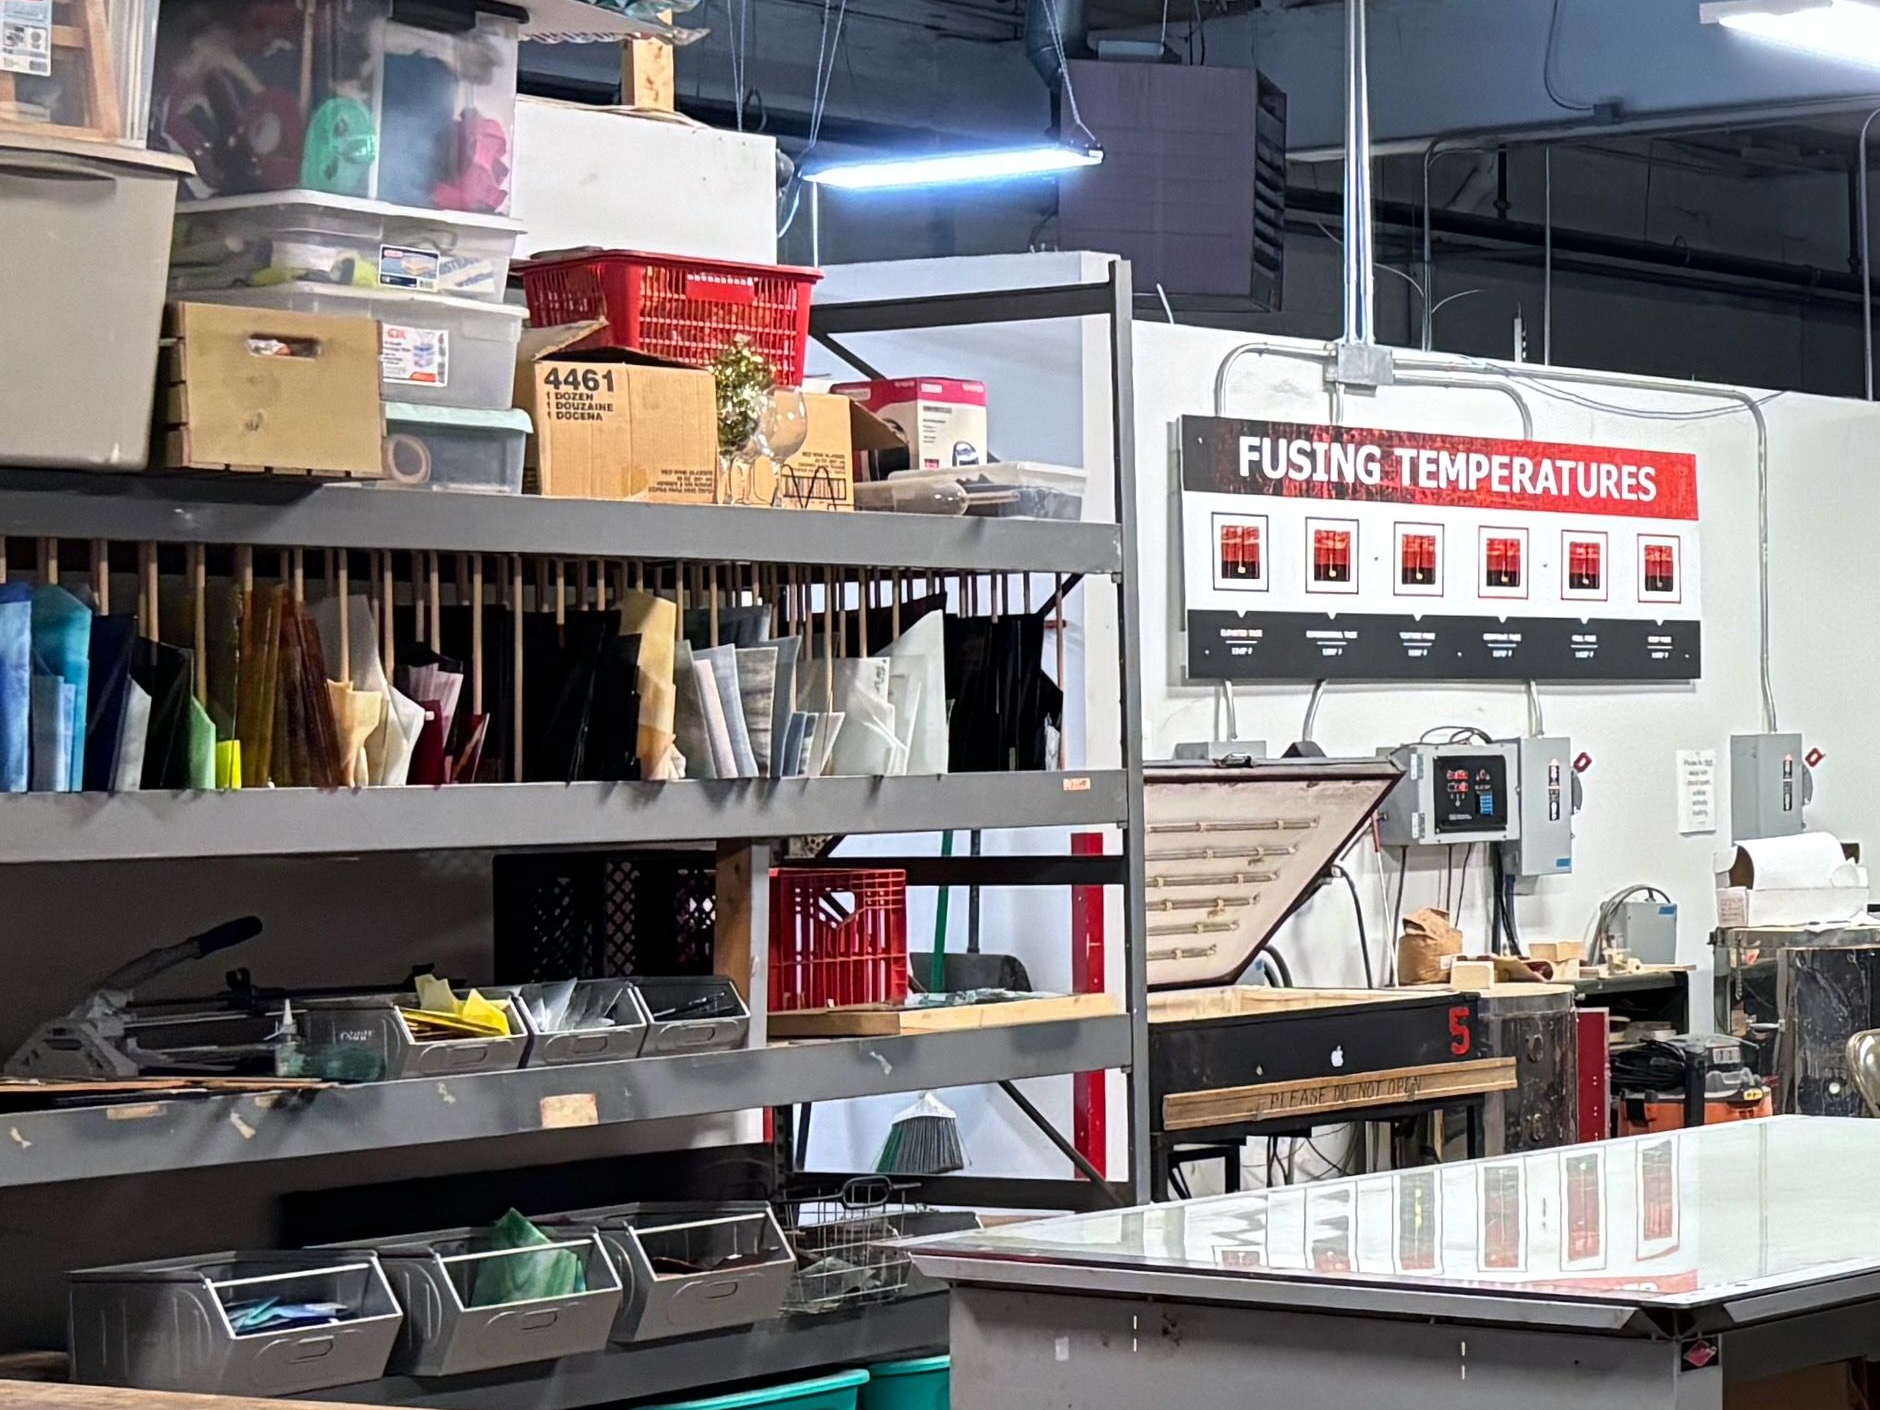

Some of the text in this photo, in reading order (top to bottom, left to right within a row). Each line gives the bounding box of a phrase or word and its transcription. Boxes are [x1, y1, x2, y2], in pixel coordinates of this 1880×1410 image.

[544, 367, 614, 392] 4461
[555, 392, 593, 401] DOZEN
[556, 401, 613, 412] DOUZAINE
[556, 411, 603, 421] DOCENA
[1238, 435, 1657, 502] FUSING TEMPERATURES
[1449, 1006, 1472, 1056] 5
[1270, 1076, 1423, 1111] PLEASE DO NOT OPEN
